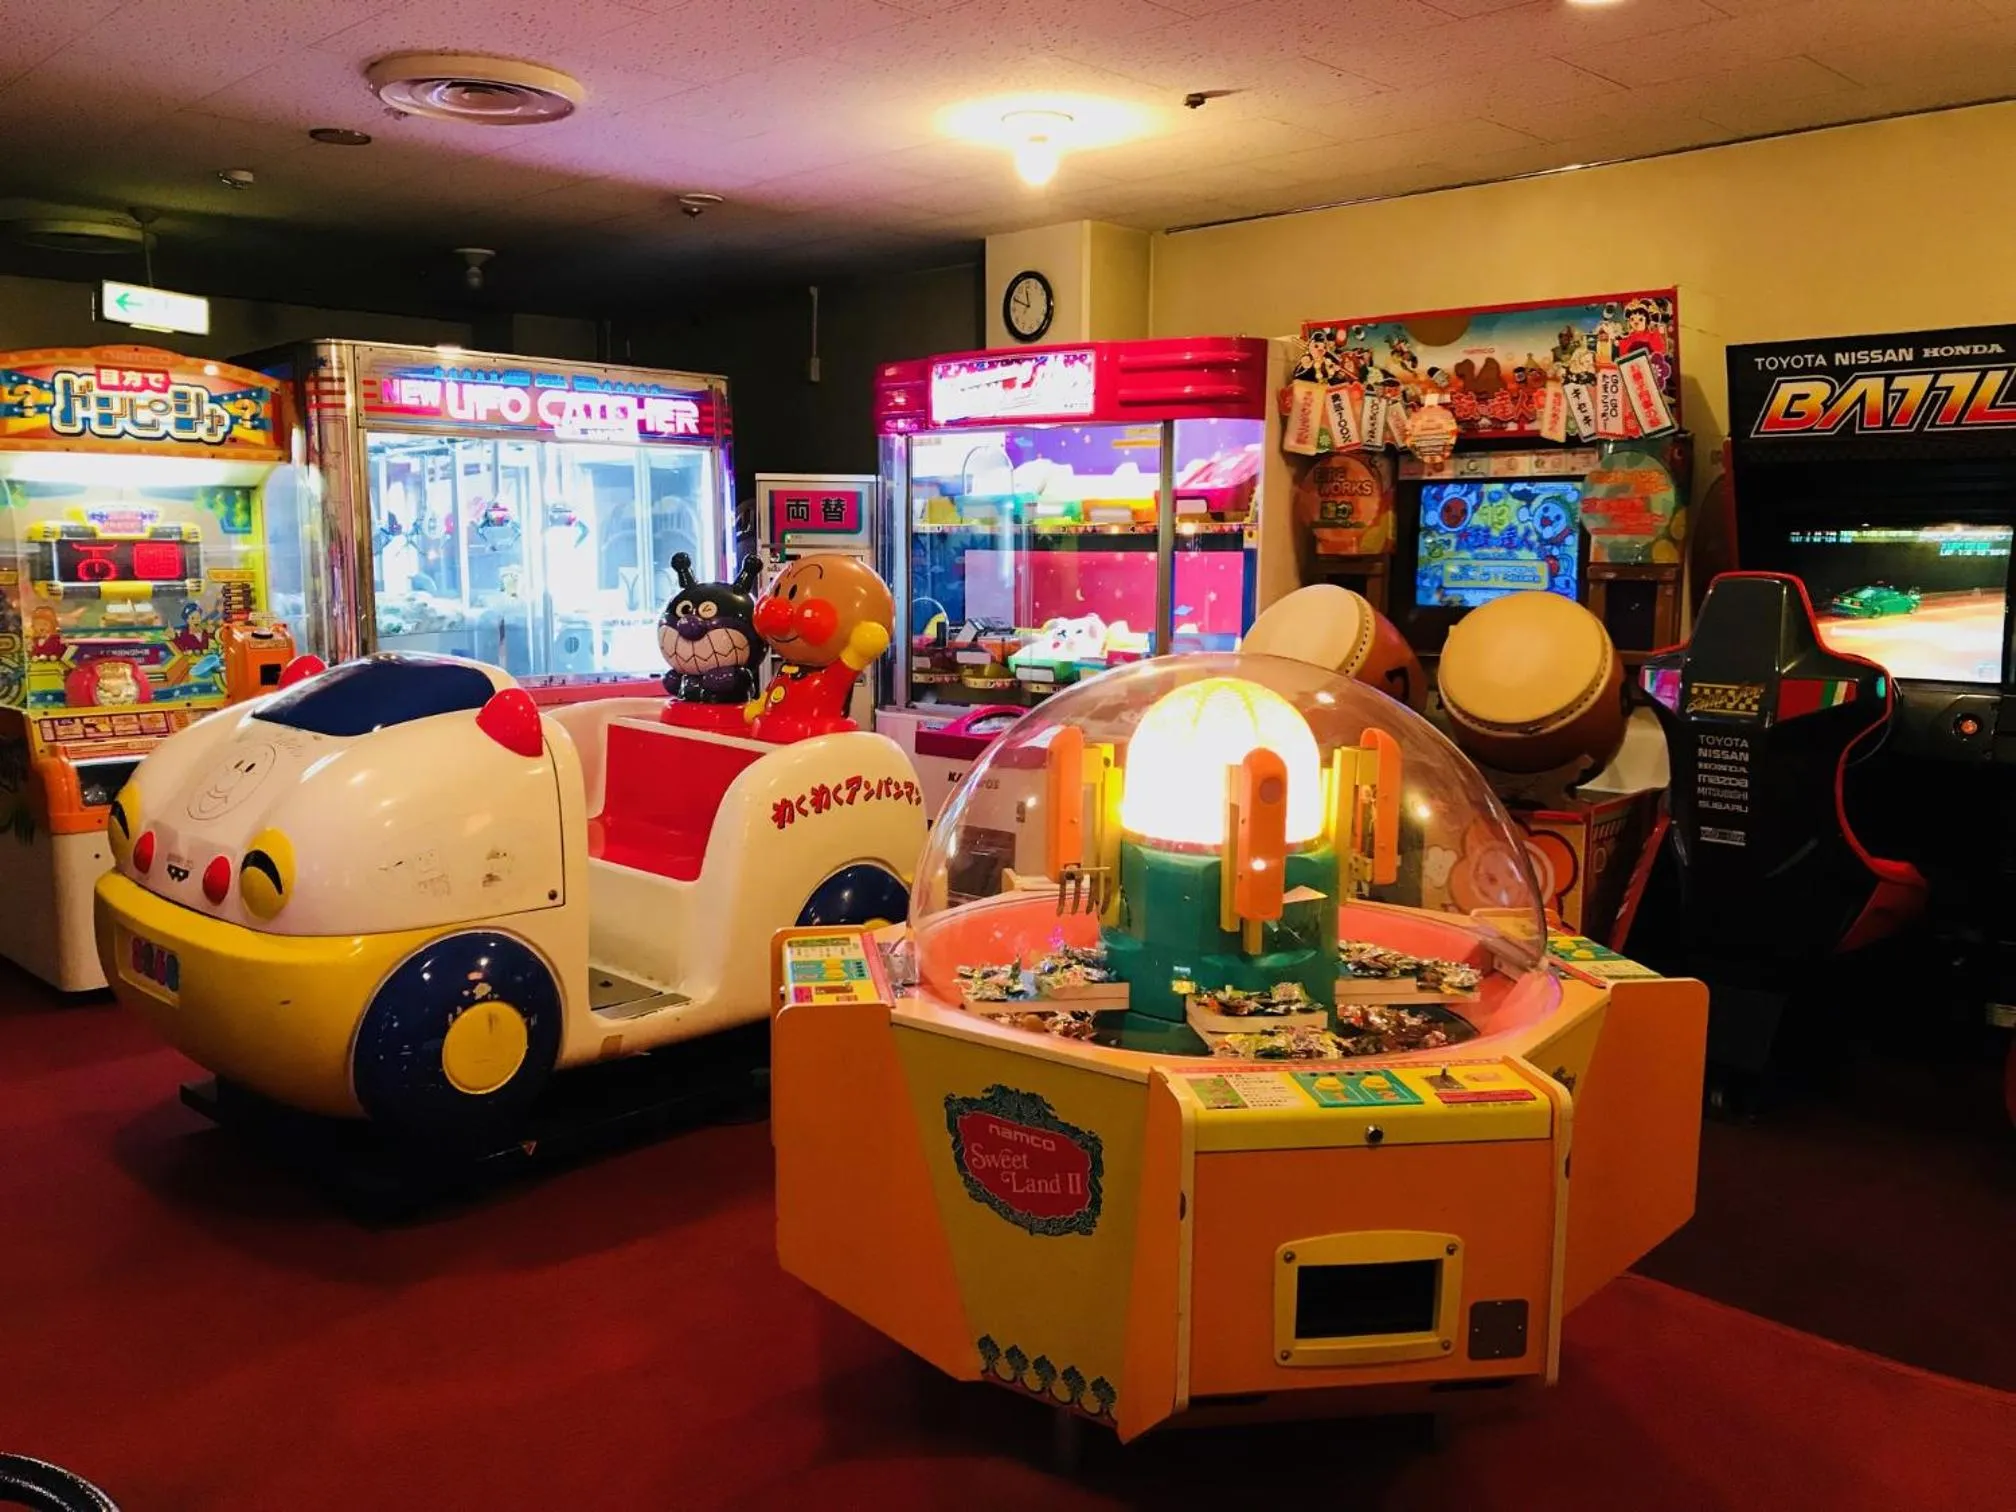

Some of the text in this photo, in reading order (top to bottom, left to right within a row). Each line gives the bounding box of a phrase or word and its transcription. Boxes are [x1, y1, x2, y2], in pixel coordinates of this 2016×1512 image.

[1754, 343, 2006, 371] TOYOTA NISSAN HONDA
[380, 377, 700, 434] NEW UFO CATCHER
[785, 496, 846, 522] 両替
[1698, 734, 1750, 749] TOYOTA
[1697, 747, 1750, 762] NISSAN
[1697, 761, 1749, 774] HONDA
[1696, 786, 1749, 800] MITSUBISHI
[1698, 800, 1749, 813] SUBARU
[988, 1123, 1057, 1152] namco
[970, 1142, 1030, 1170] Sweet
[1000, 1170, 1083, 1195] Land II
